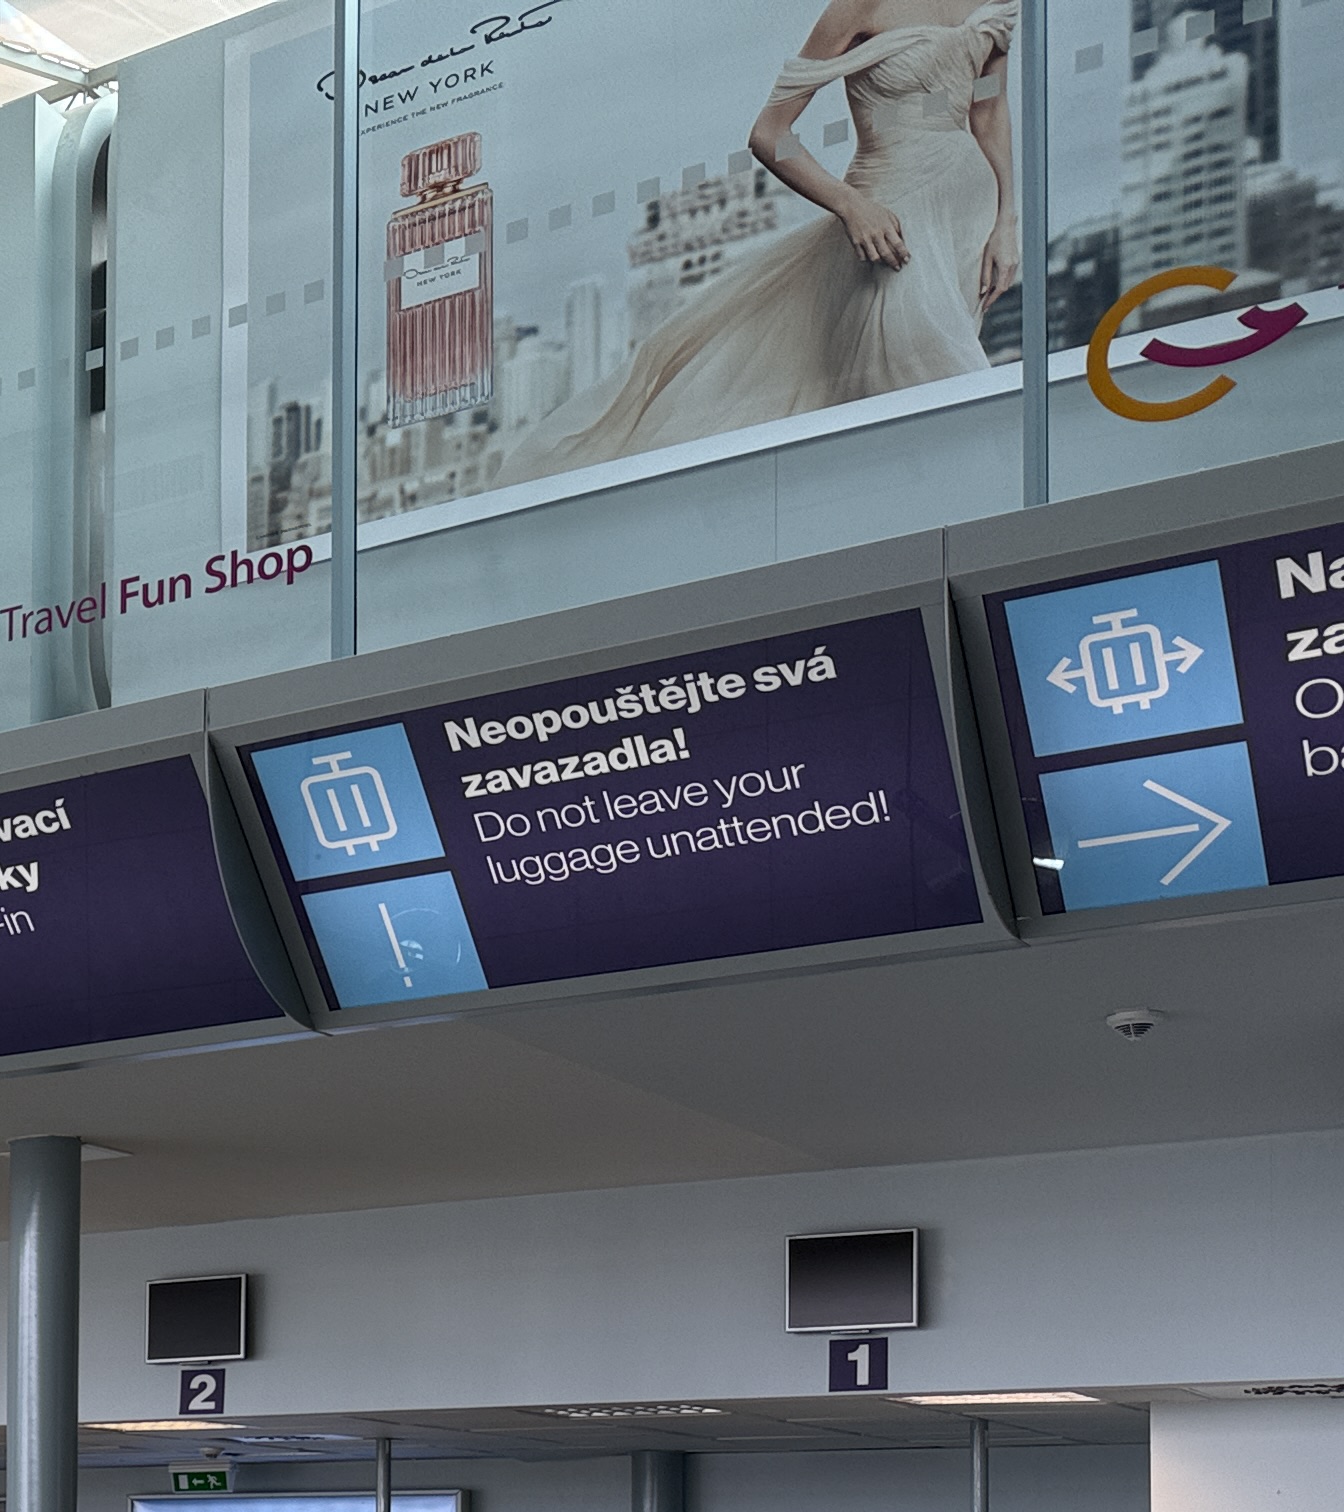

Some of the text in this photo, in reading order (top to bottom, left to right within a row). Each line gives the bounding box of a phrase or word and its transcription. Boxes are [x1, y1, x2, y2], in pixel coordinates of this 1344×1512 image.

[359, 115, 409, 136] XPERIENCE
[451, 82, 504, 106] FRAGRANCE
[364, 60, 495, 117] NEW YORK
[0, 544, 313, 641] Travel Fun Shop
[443, 645, 838, 752] Neopouštějte svá
[461, 727, 692, 798] zavazadla!
[473, 762, 806, 843] Do not leave your
[486, 789, 892, 885] luggage unattended!
[188, 1374, 216, 1411] 2
[847, 1343, 870, 1386] 1
